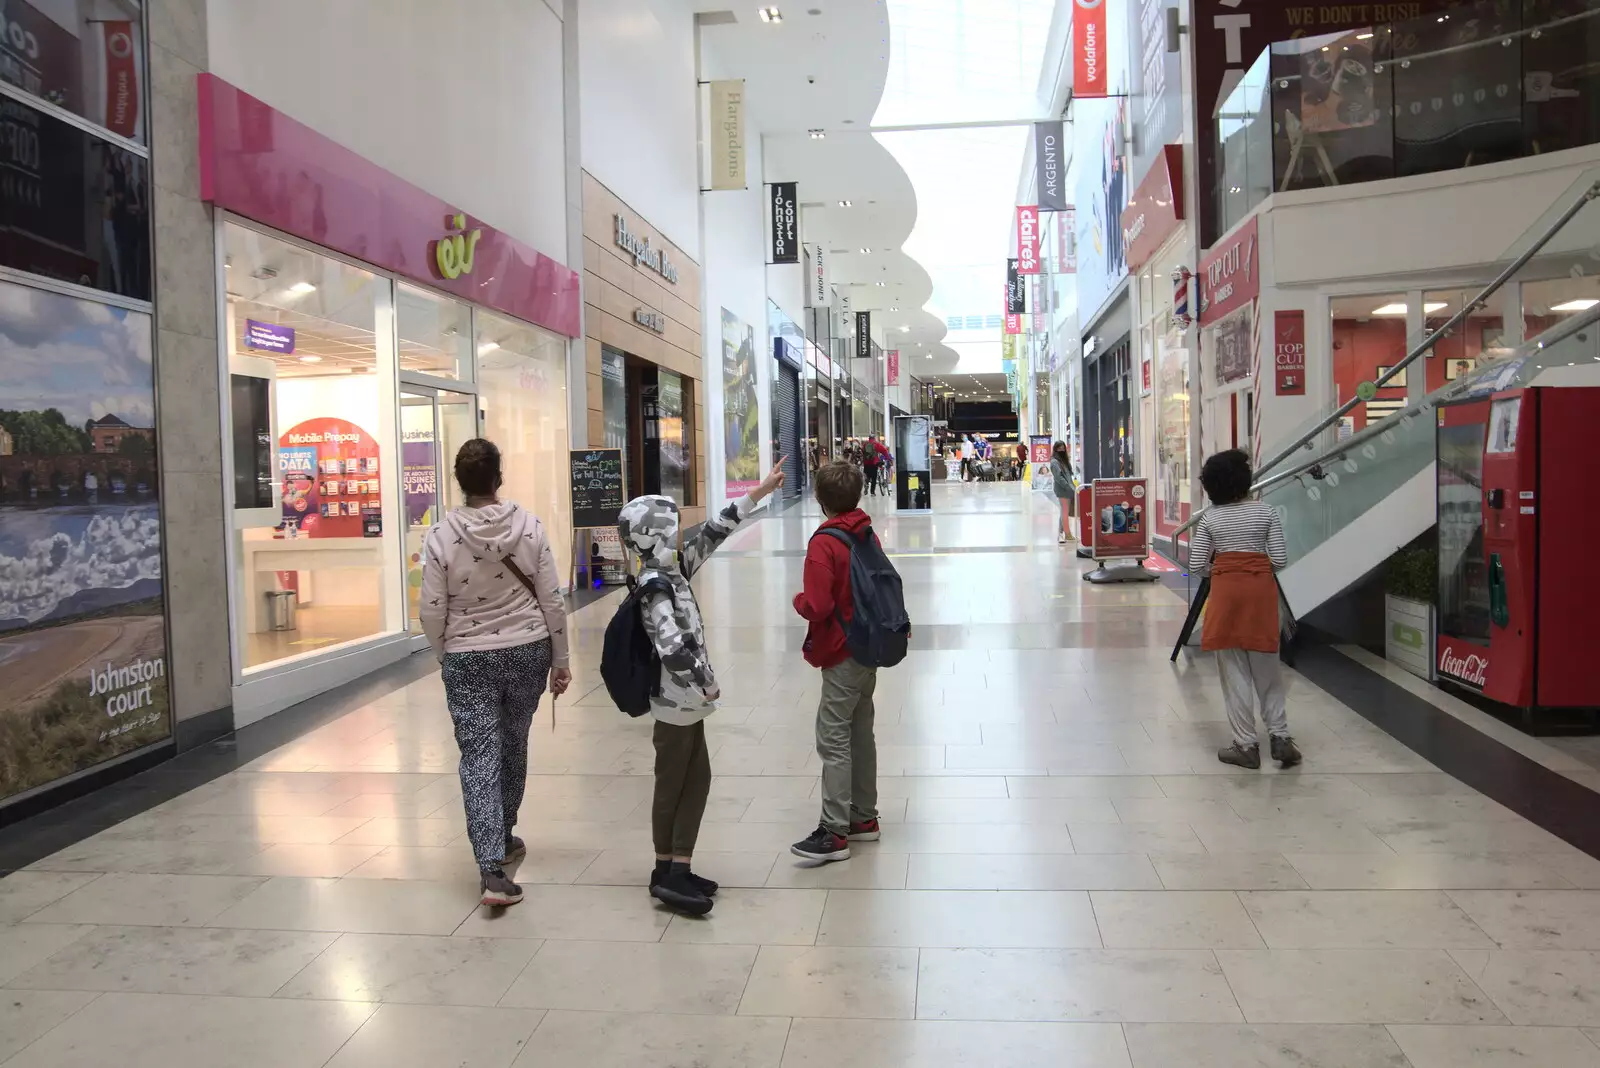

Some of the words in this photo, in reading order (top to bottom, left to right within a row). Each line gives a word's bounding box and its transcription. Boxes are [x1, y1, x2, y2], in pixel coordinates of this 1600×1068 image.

[1285, 7, 1314, 25] WE
[1320, 4, 1369, 24] DON'T
[1373, 2, 1421, 22] RUSH
[1084, 23, 1097, 83] vodafone
[724, 92, 742, 178] Hargadons
[1045, 135, 1056, 196] ARGENTO
[613, 212, 660, 270] Hargadon
[775, 186, 785, 255] Johnston
[785, 200, 794, 239] court
[1020, 210, 1037, 270] claire's
[436, 213, 481, 279] eir
[1208, 258, 1222, 290] TOP
[1223, 242, 1240, 278] CUT
[1276, 343, 1303, 353] TOP
[1276, 354, 1304, 365] CUT
[289, 433, 322, 443] Mobile
[324, 432, 360, 444] Prepay
[279, 458, 312, 470] DATA
[89, 658, 164, 697] Johnston
[106, 682, 153, 717] court
